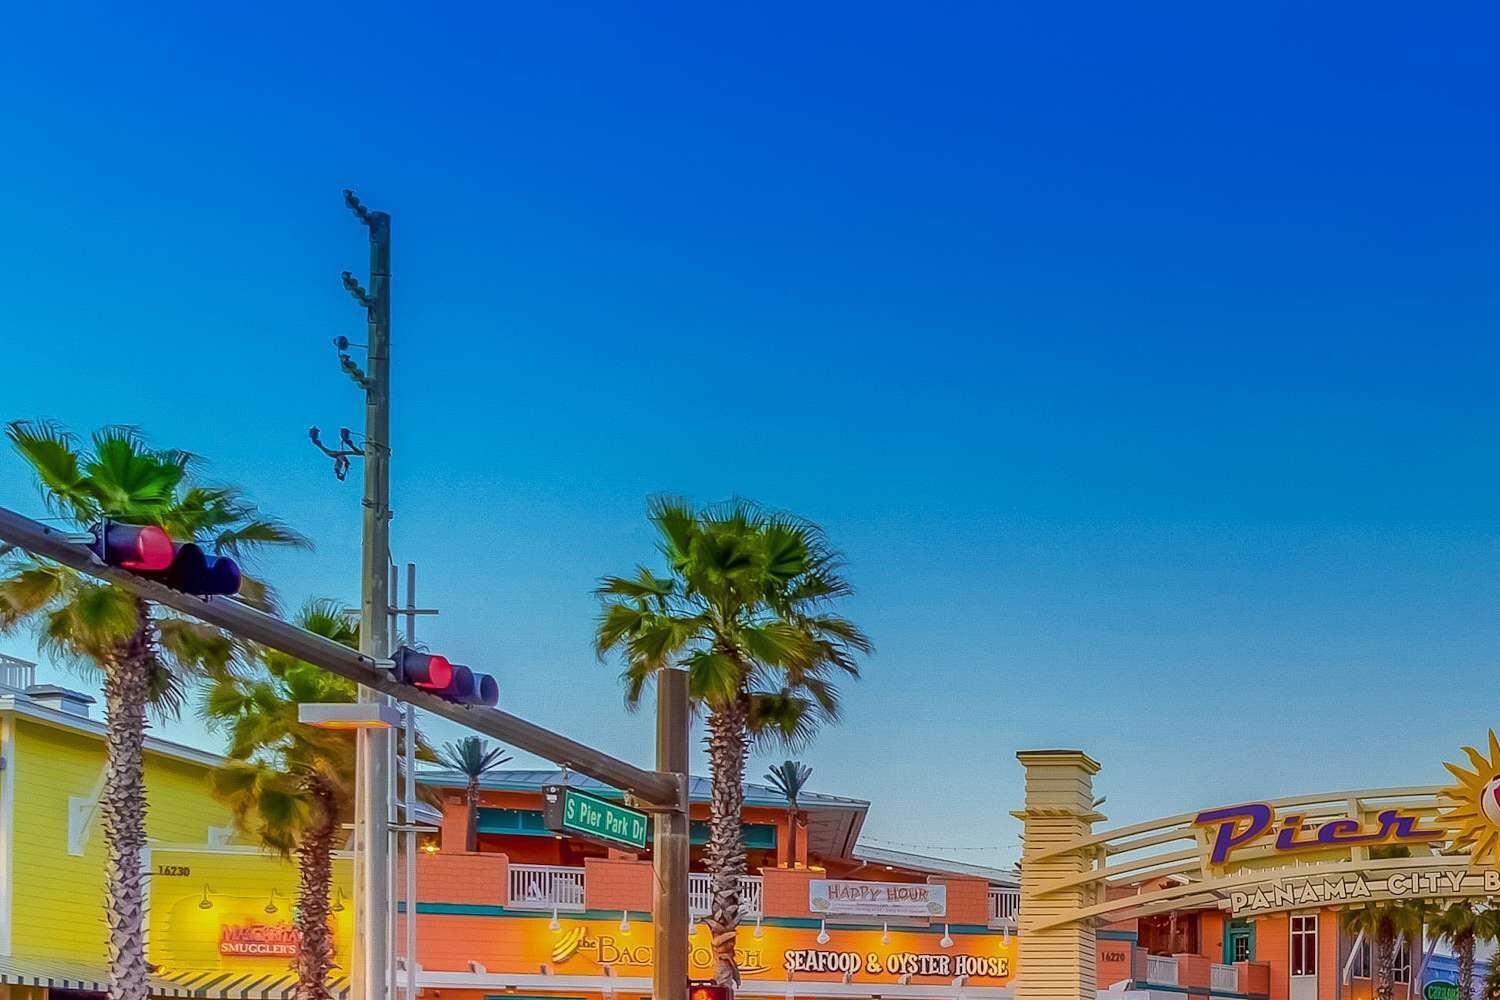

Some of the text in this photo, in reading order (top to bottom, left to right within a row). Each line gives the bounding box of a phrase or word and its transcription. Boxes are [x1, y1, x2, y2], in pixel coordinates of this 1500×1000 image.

[567, 798, 643, 840] S Pier Park Dr
[1193, 803, 1448, 866] Pier
[158, 865, 191, 877] 16230
[828, 885, 929, 902] HAPPY HOUR
[1230, 871, 1372, 914] PANAMA
[1386, 868, 1468, 896] CITY
[220, 943, 297, 955] SMUGGLER'S
[784, 949, 1009, 977] SEAFOOD & OYSTER HOUSE
